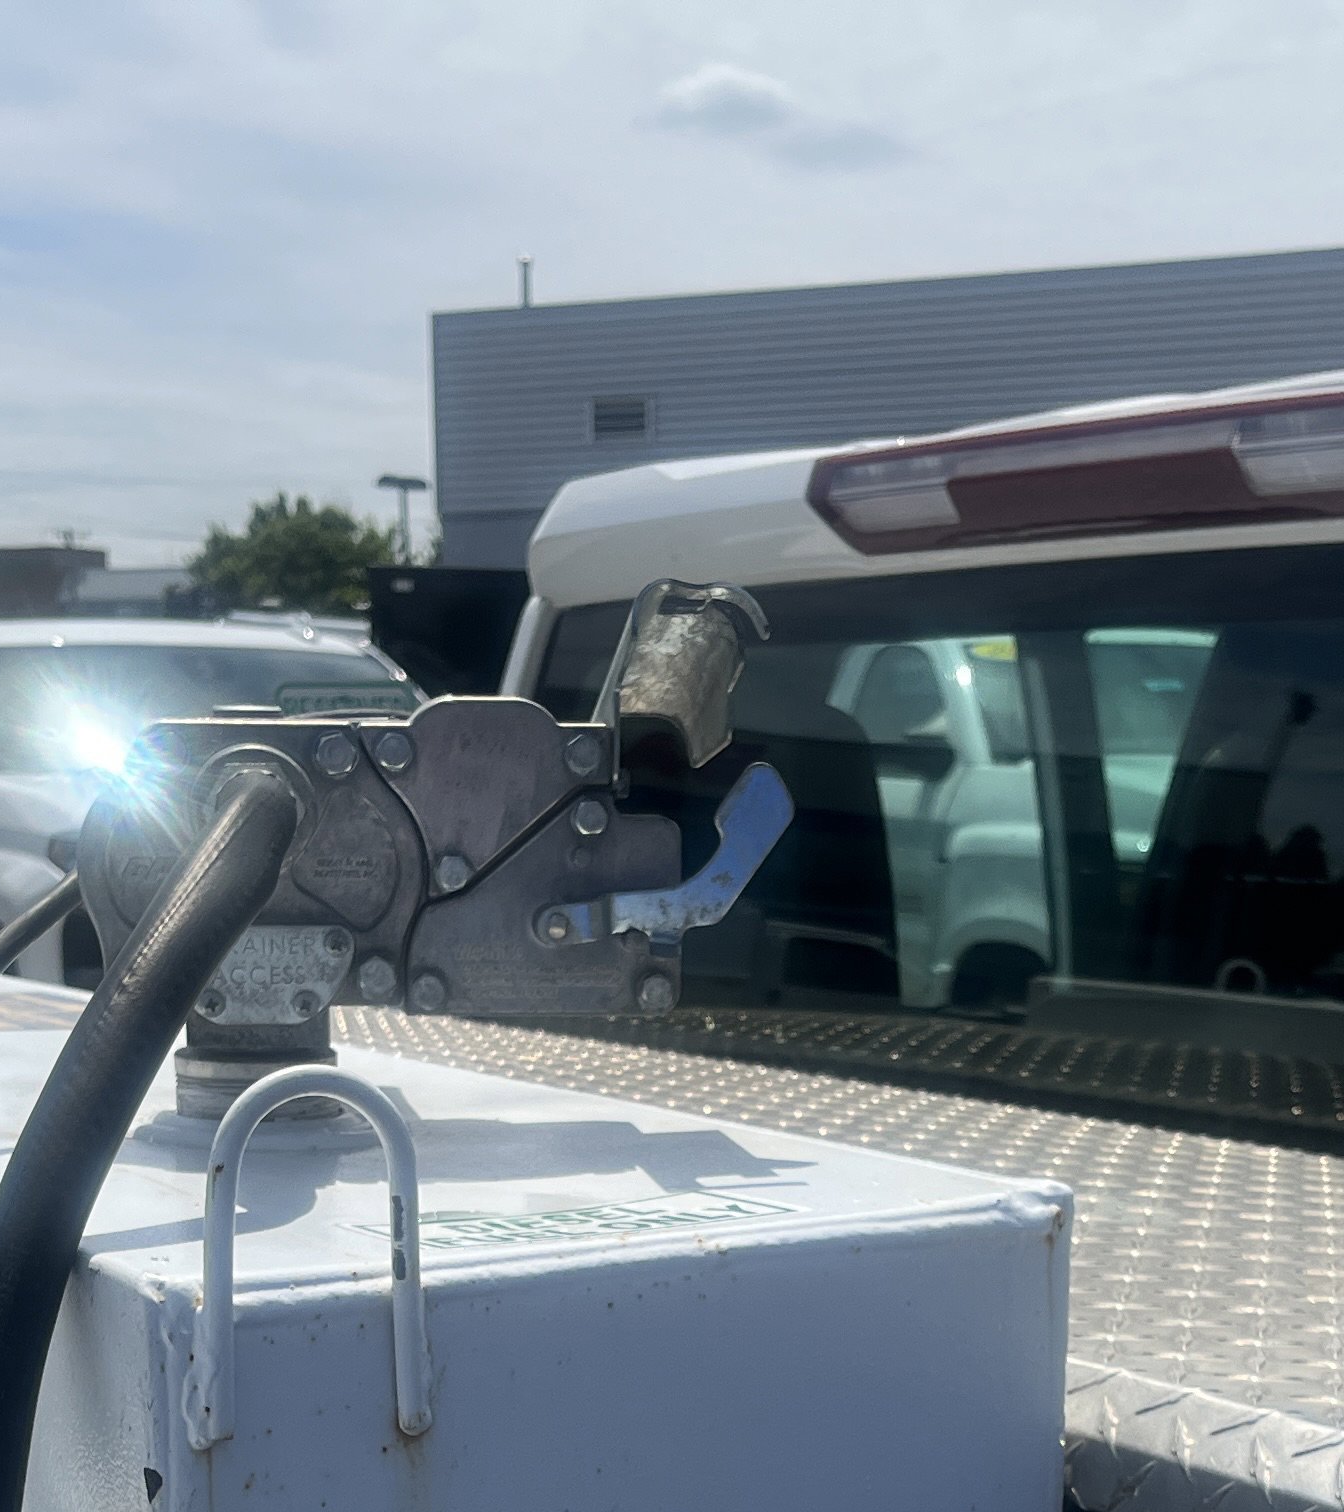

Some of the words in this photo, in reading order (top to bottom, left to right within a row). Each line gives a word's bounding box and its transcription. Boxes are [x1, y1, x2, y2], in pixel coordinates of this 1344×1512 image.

[233, 935, 316, 955] AINER
[433, 1229, 598, 1249] FUEL
[597, 1203, 759, 1231] ONLY
[442, 1206, 669, 1235] DIESEL
